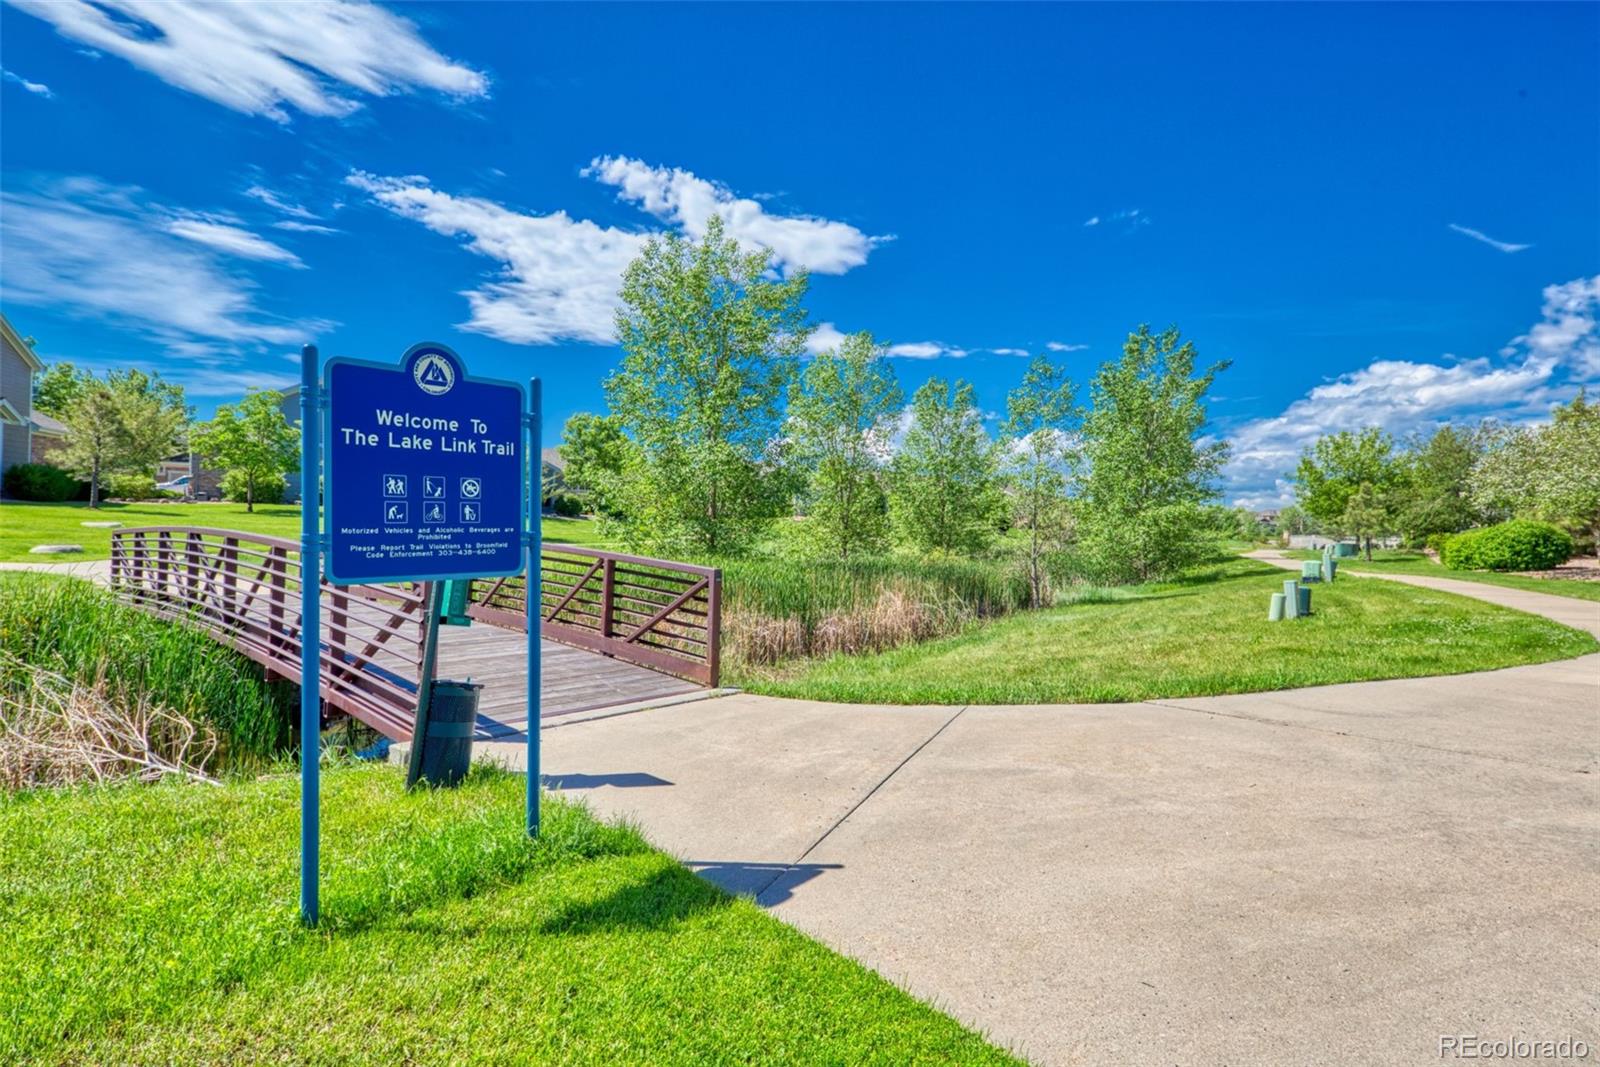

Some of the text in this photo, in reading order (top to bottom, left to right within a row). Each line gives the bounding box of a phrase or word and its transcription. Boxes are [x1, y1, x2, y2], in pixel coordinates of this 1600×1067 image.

[376, 409, 488, 434] Welcome To
[341, 428, 514, 456] The Lake Link Trail
[469, 526, 501, 534] Beverages
[366, 551, 384, 559] Code
[389, 550, 433, 558] Enforcement
